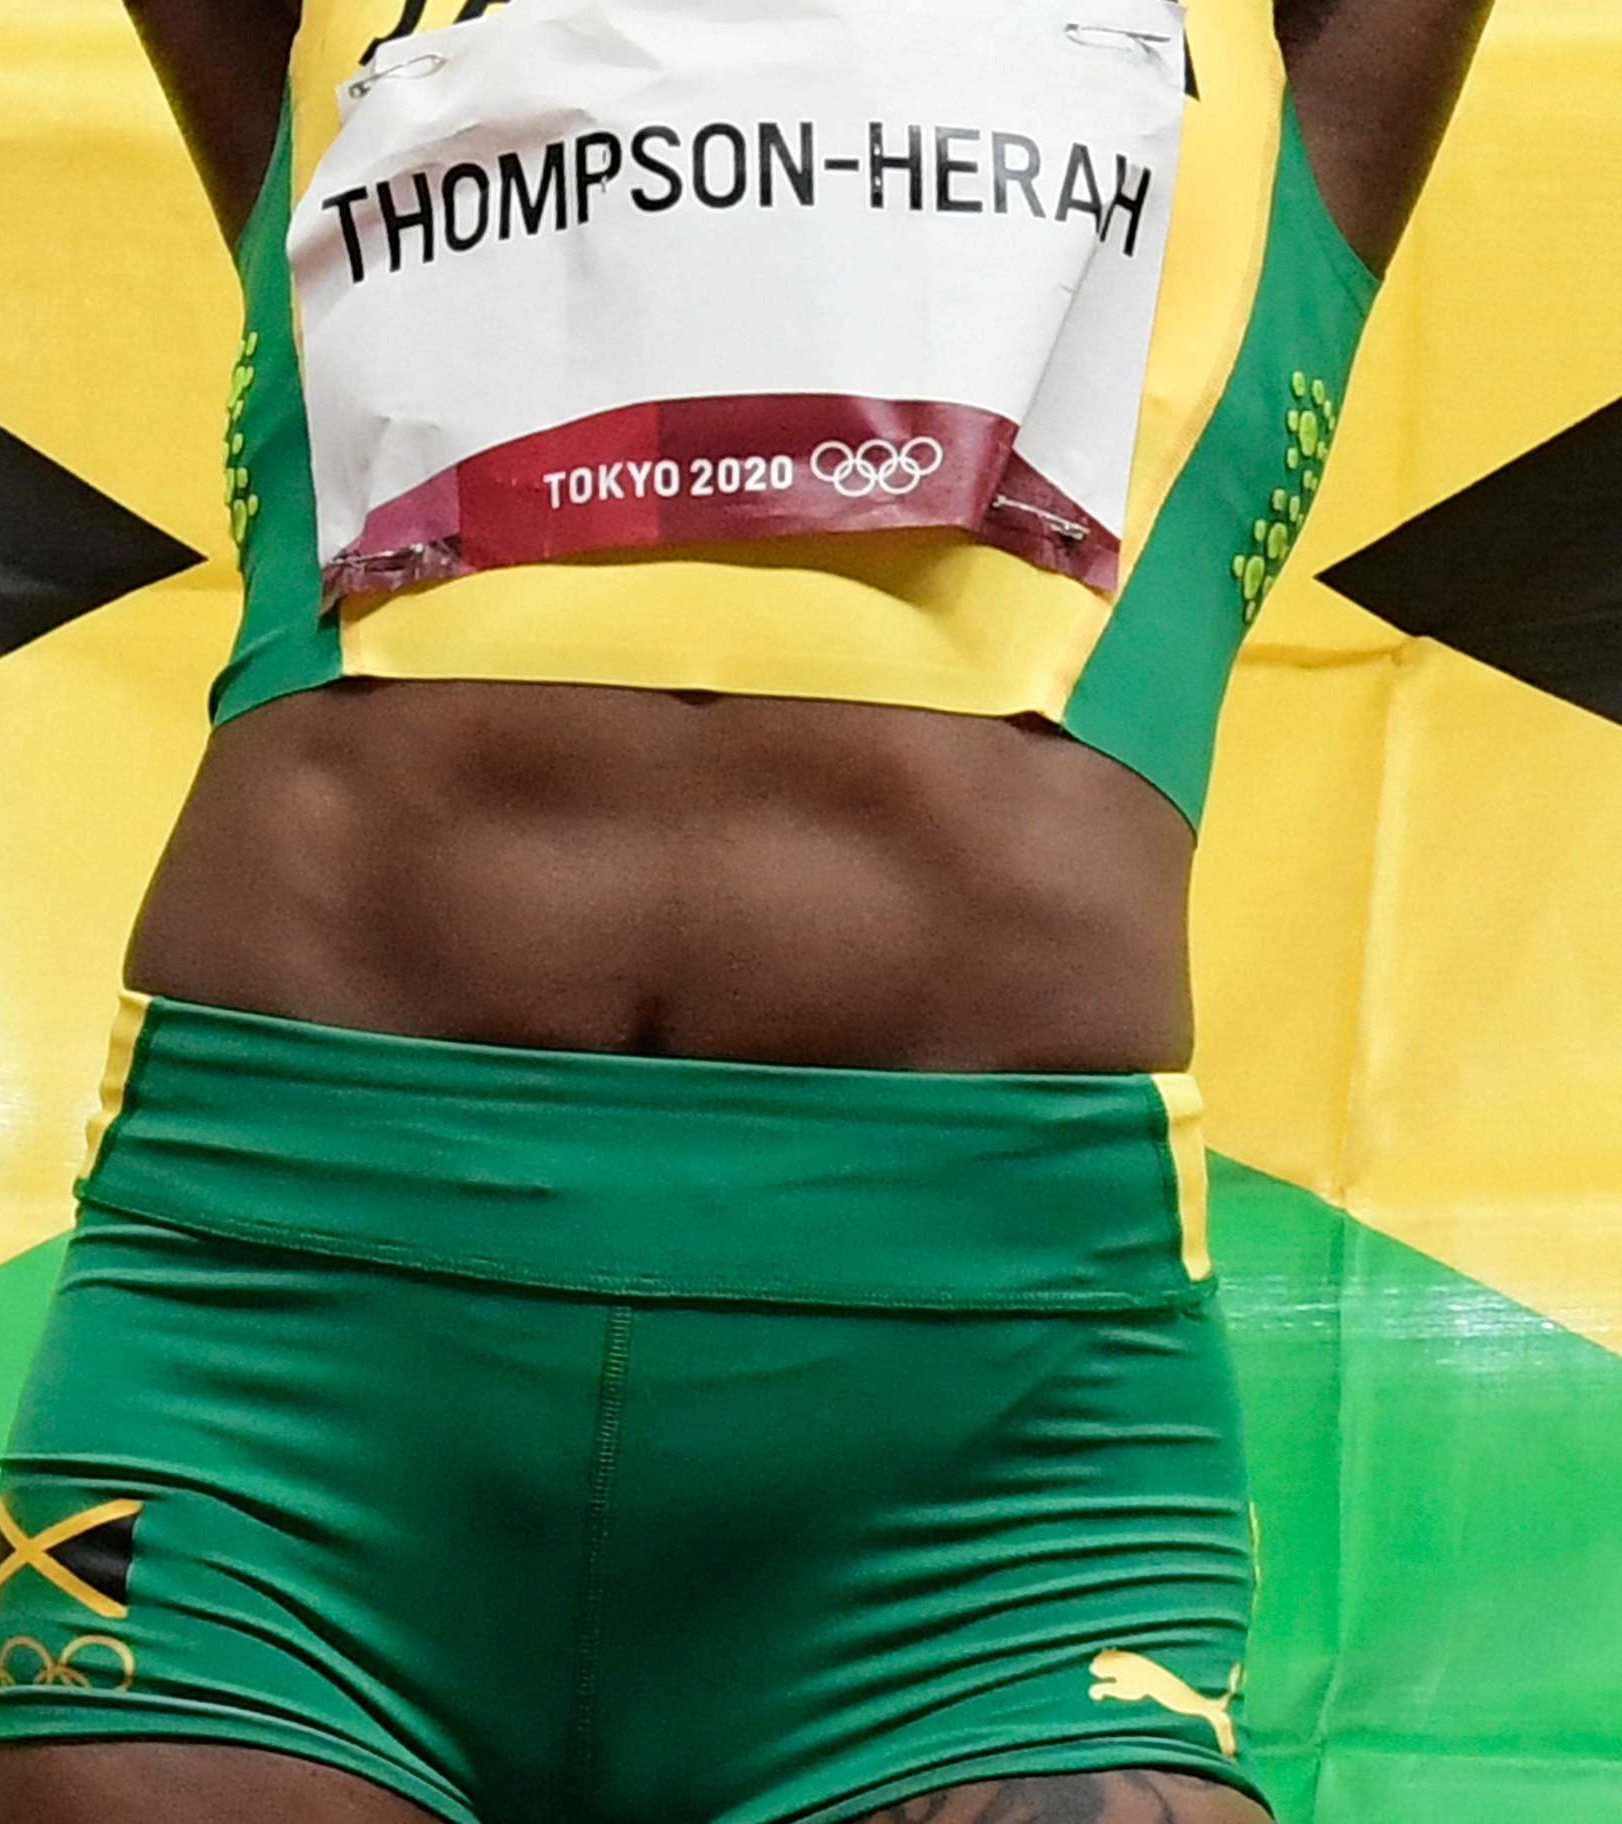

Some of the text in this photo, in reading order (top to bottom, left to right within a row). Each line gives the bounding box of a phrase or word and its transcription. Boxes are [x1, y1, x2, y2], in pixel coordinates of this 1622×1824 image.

[322, 120, 1152, 285] THOMPSON-HERAH
[543, 455, 794, 509] TOKYO 2020
